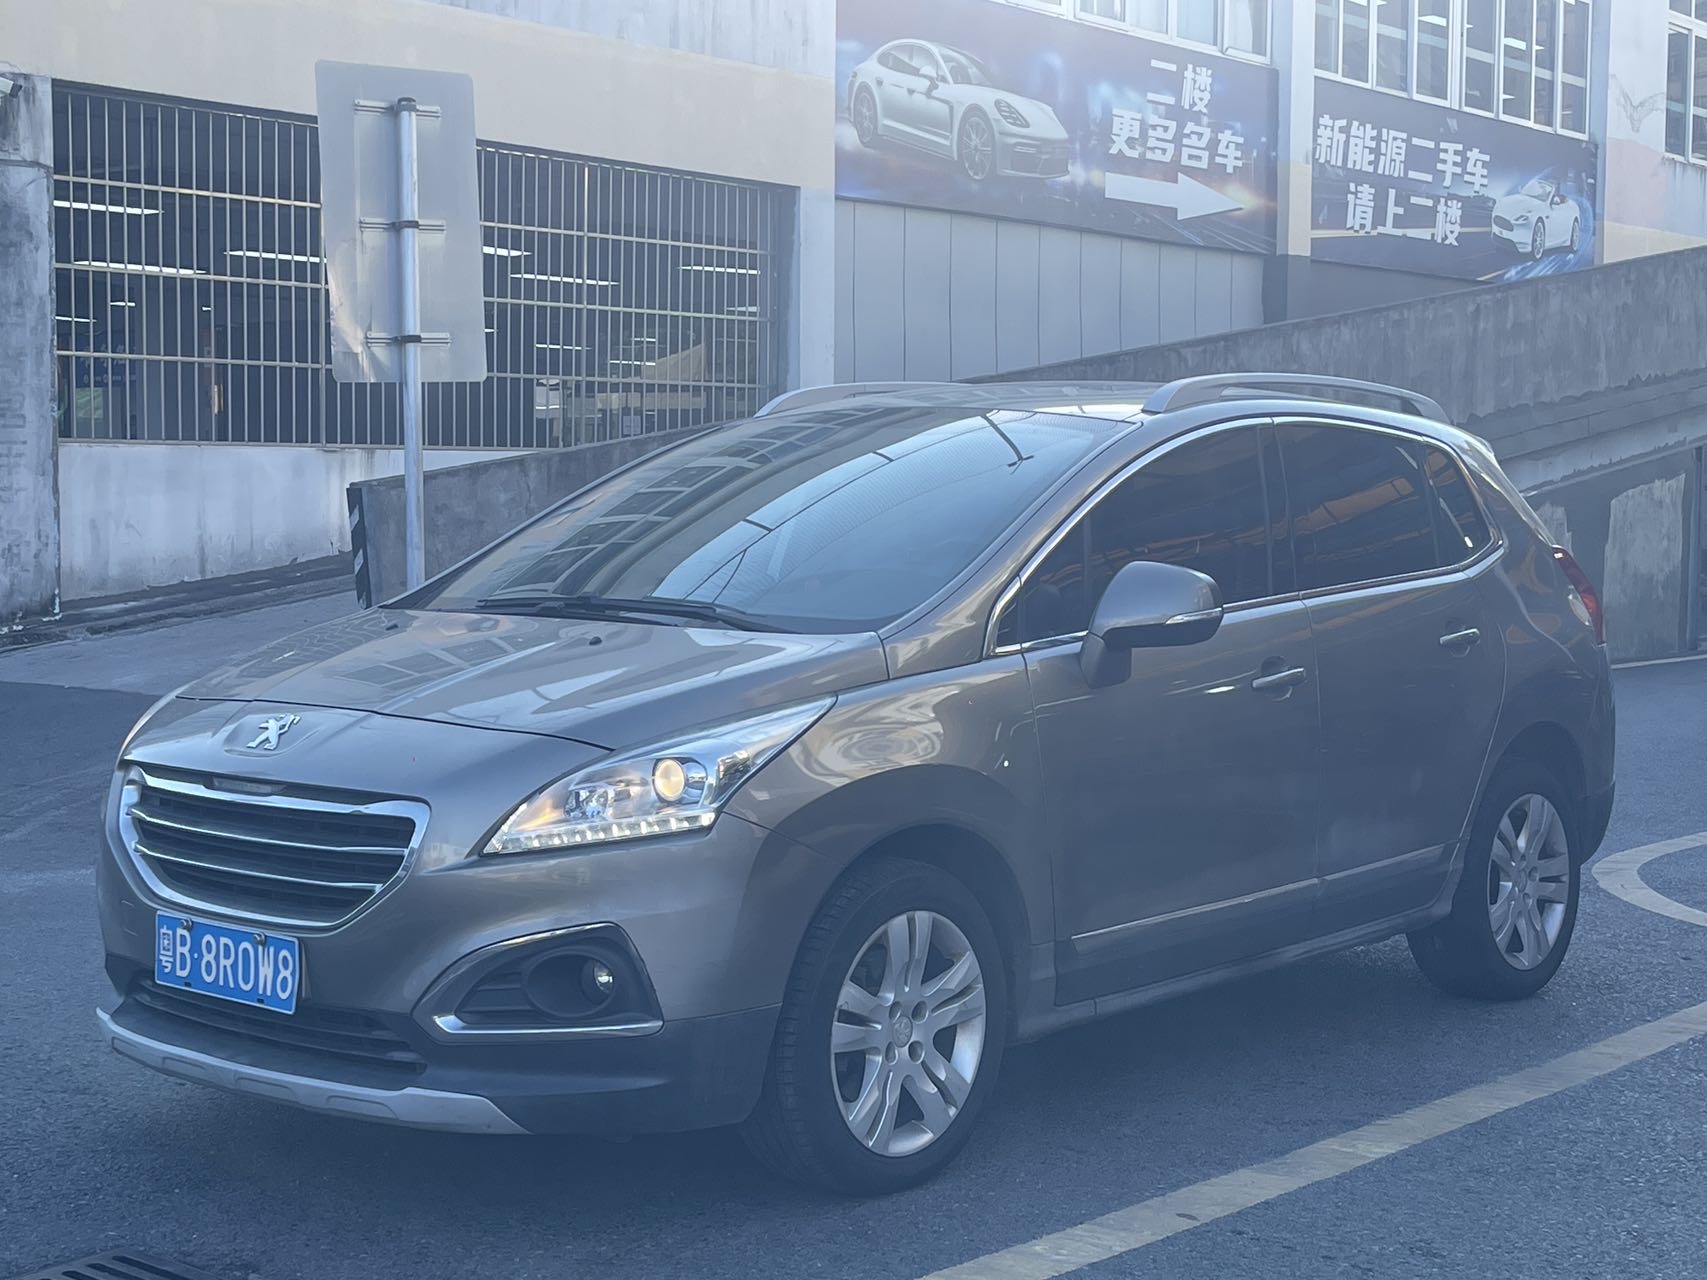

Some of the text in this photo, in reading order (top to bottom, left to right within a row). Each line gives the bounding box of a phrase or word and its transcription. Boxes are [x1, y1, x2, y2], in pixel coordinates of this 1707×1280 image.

[1146, 59, 1212, 115] 二楼
[1109, 109, 1245, 174] 更多名车
[1315, 114, 1491, 198] 新能源二手车
[1346, 182, 1463, 246] 请上二楼
